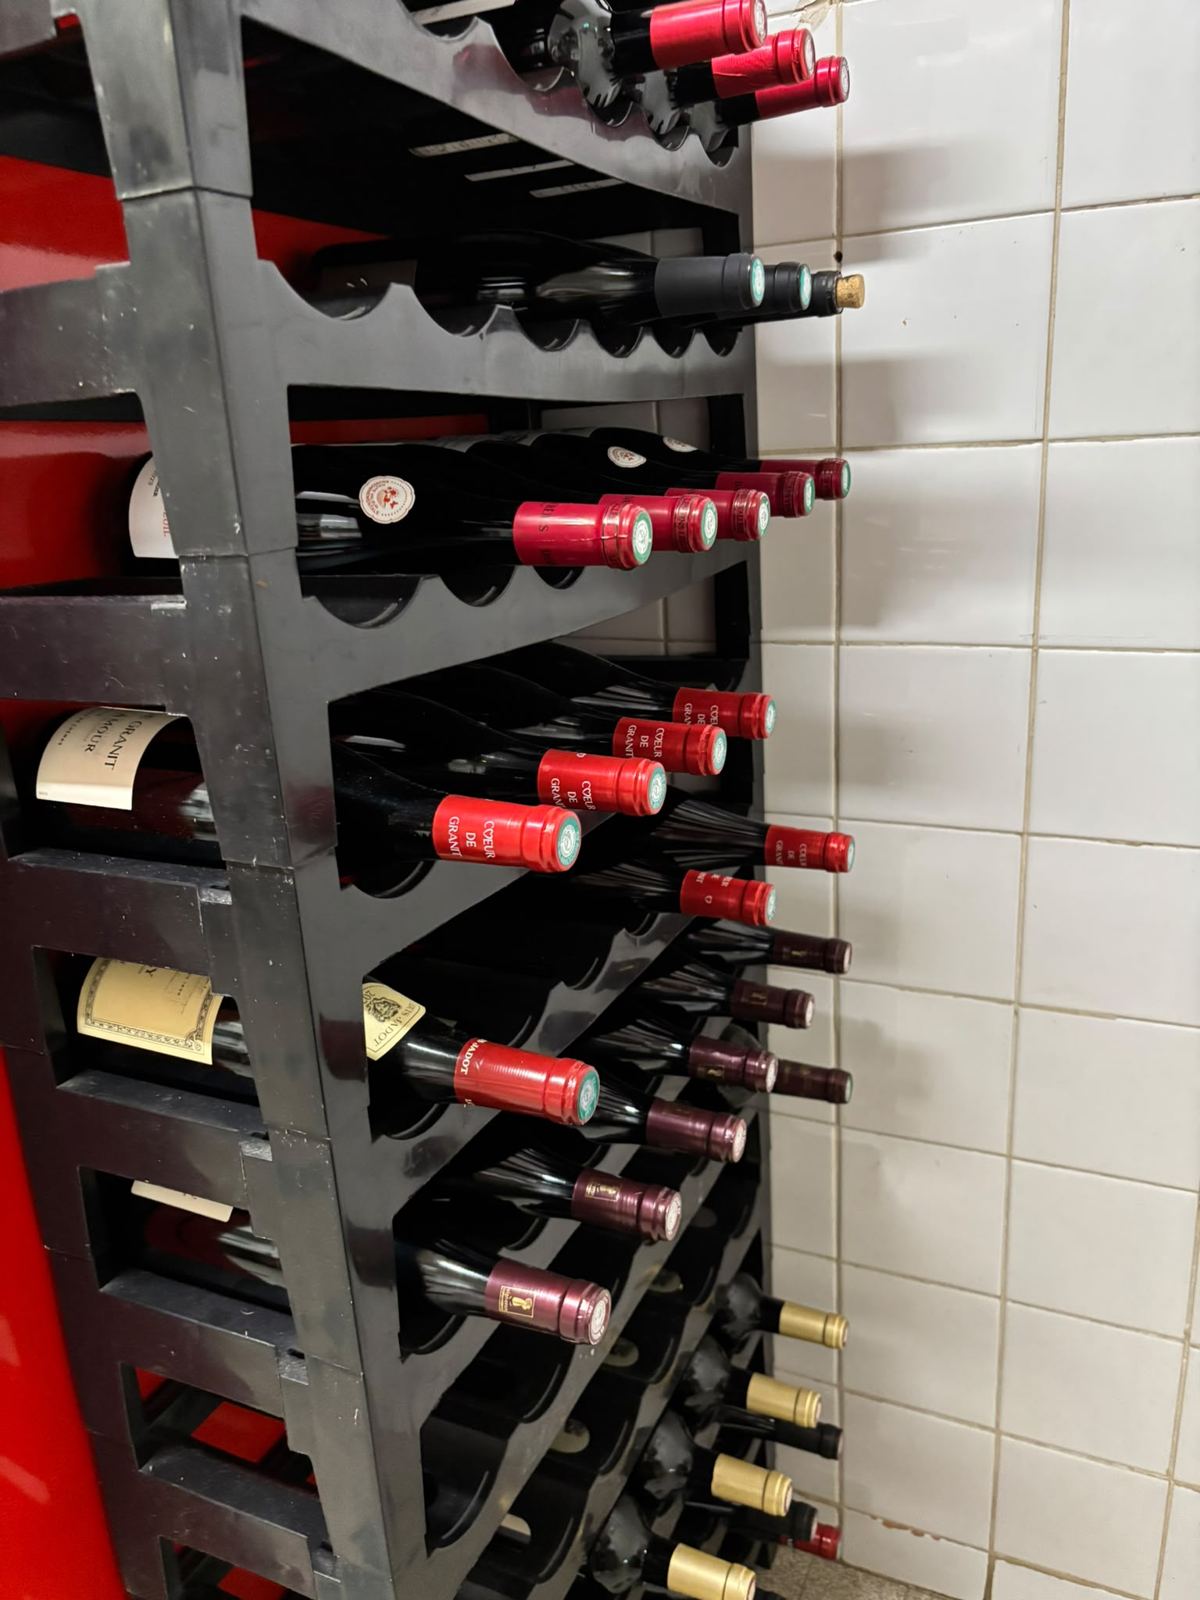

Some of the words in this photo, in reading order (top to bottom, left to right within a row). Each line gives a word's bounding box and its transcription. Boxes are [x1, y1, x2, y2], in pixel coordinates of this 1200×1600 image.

[104, 721, 143, 770] GRANIT
[625, 724, 638, 758] GRANIT
[640, 734, 650, 748] DE
[567, 790, 577, 804] DE
[447, 815, 462, 858] GRANIT
[465, 831, 478, 848] DE
[374, 1016, 402, 1046] JADOT
[461, 1041, 479, 1076] JADOT
